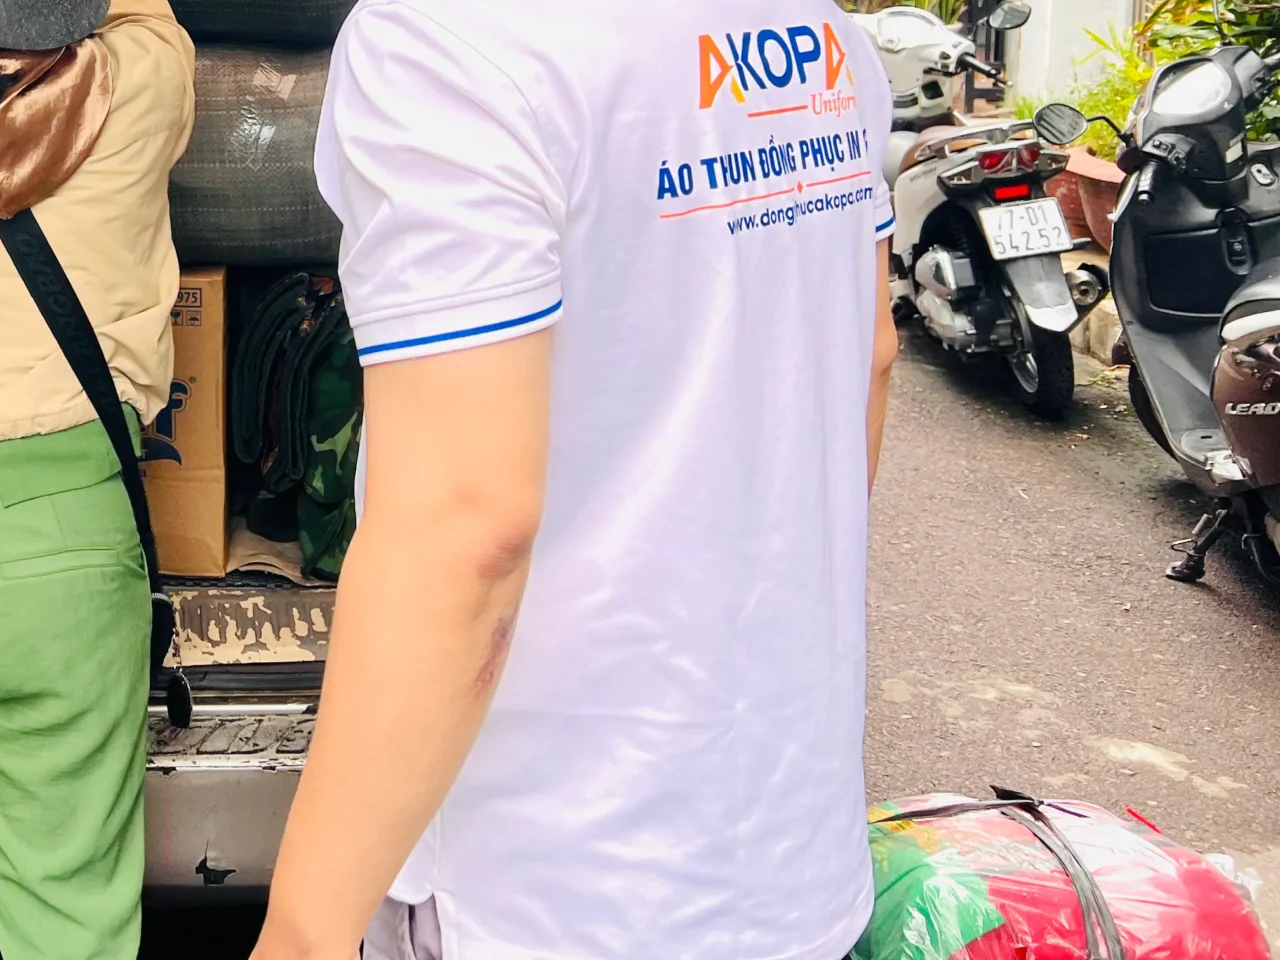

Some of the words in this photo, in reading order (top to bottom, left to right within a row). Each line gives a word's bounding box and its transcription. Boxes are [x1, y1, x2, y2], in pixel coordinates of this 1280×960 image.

[697, 22, 855, 110] AKOPA
[657, 159, 694, 200] ÁO
[757, 134, 797, 179] ĐỒNG
[798, 133, 845, 172] PHỤC
[846, 130, 862, 161] IN
[1224, 402, 1280, 416] LEAD
